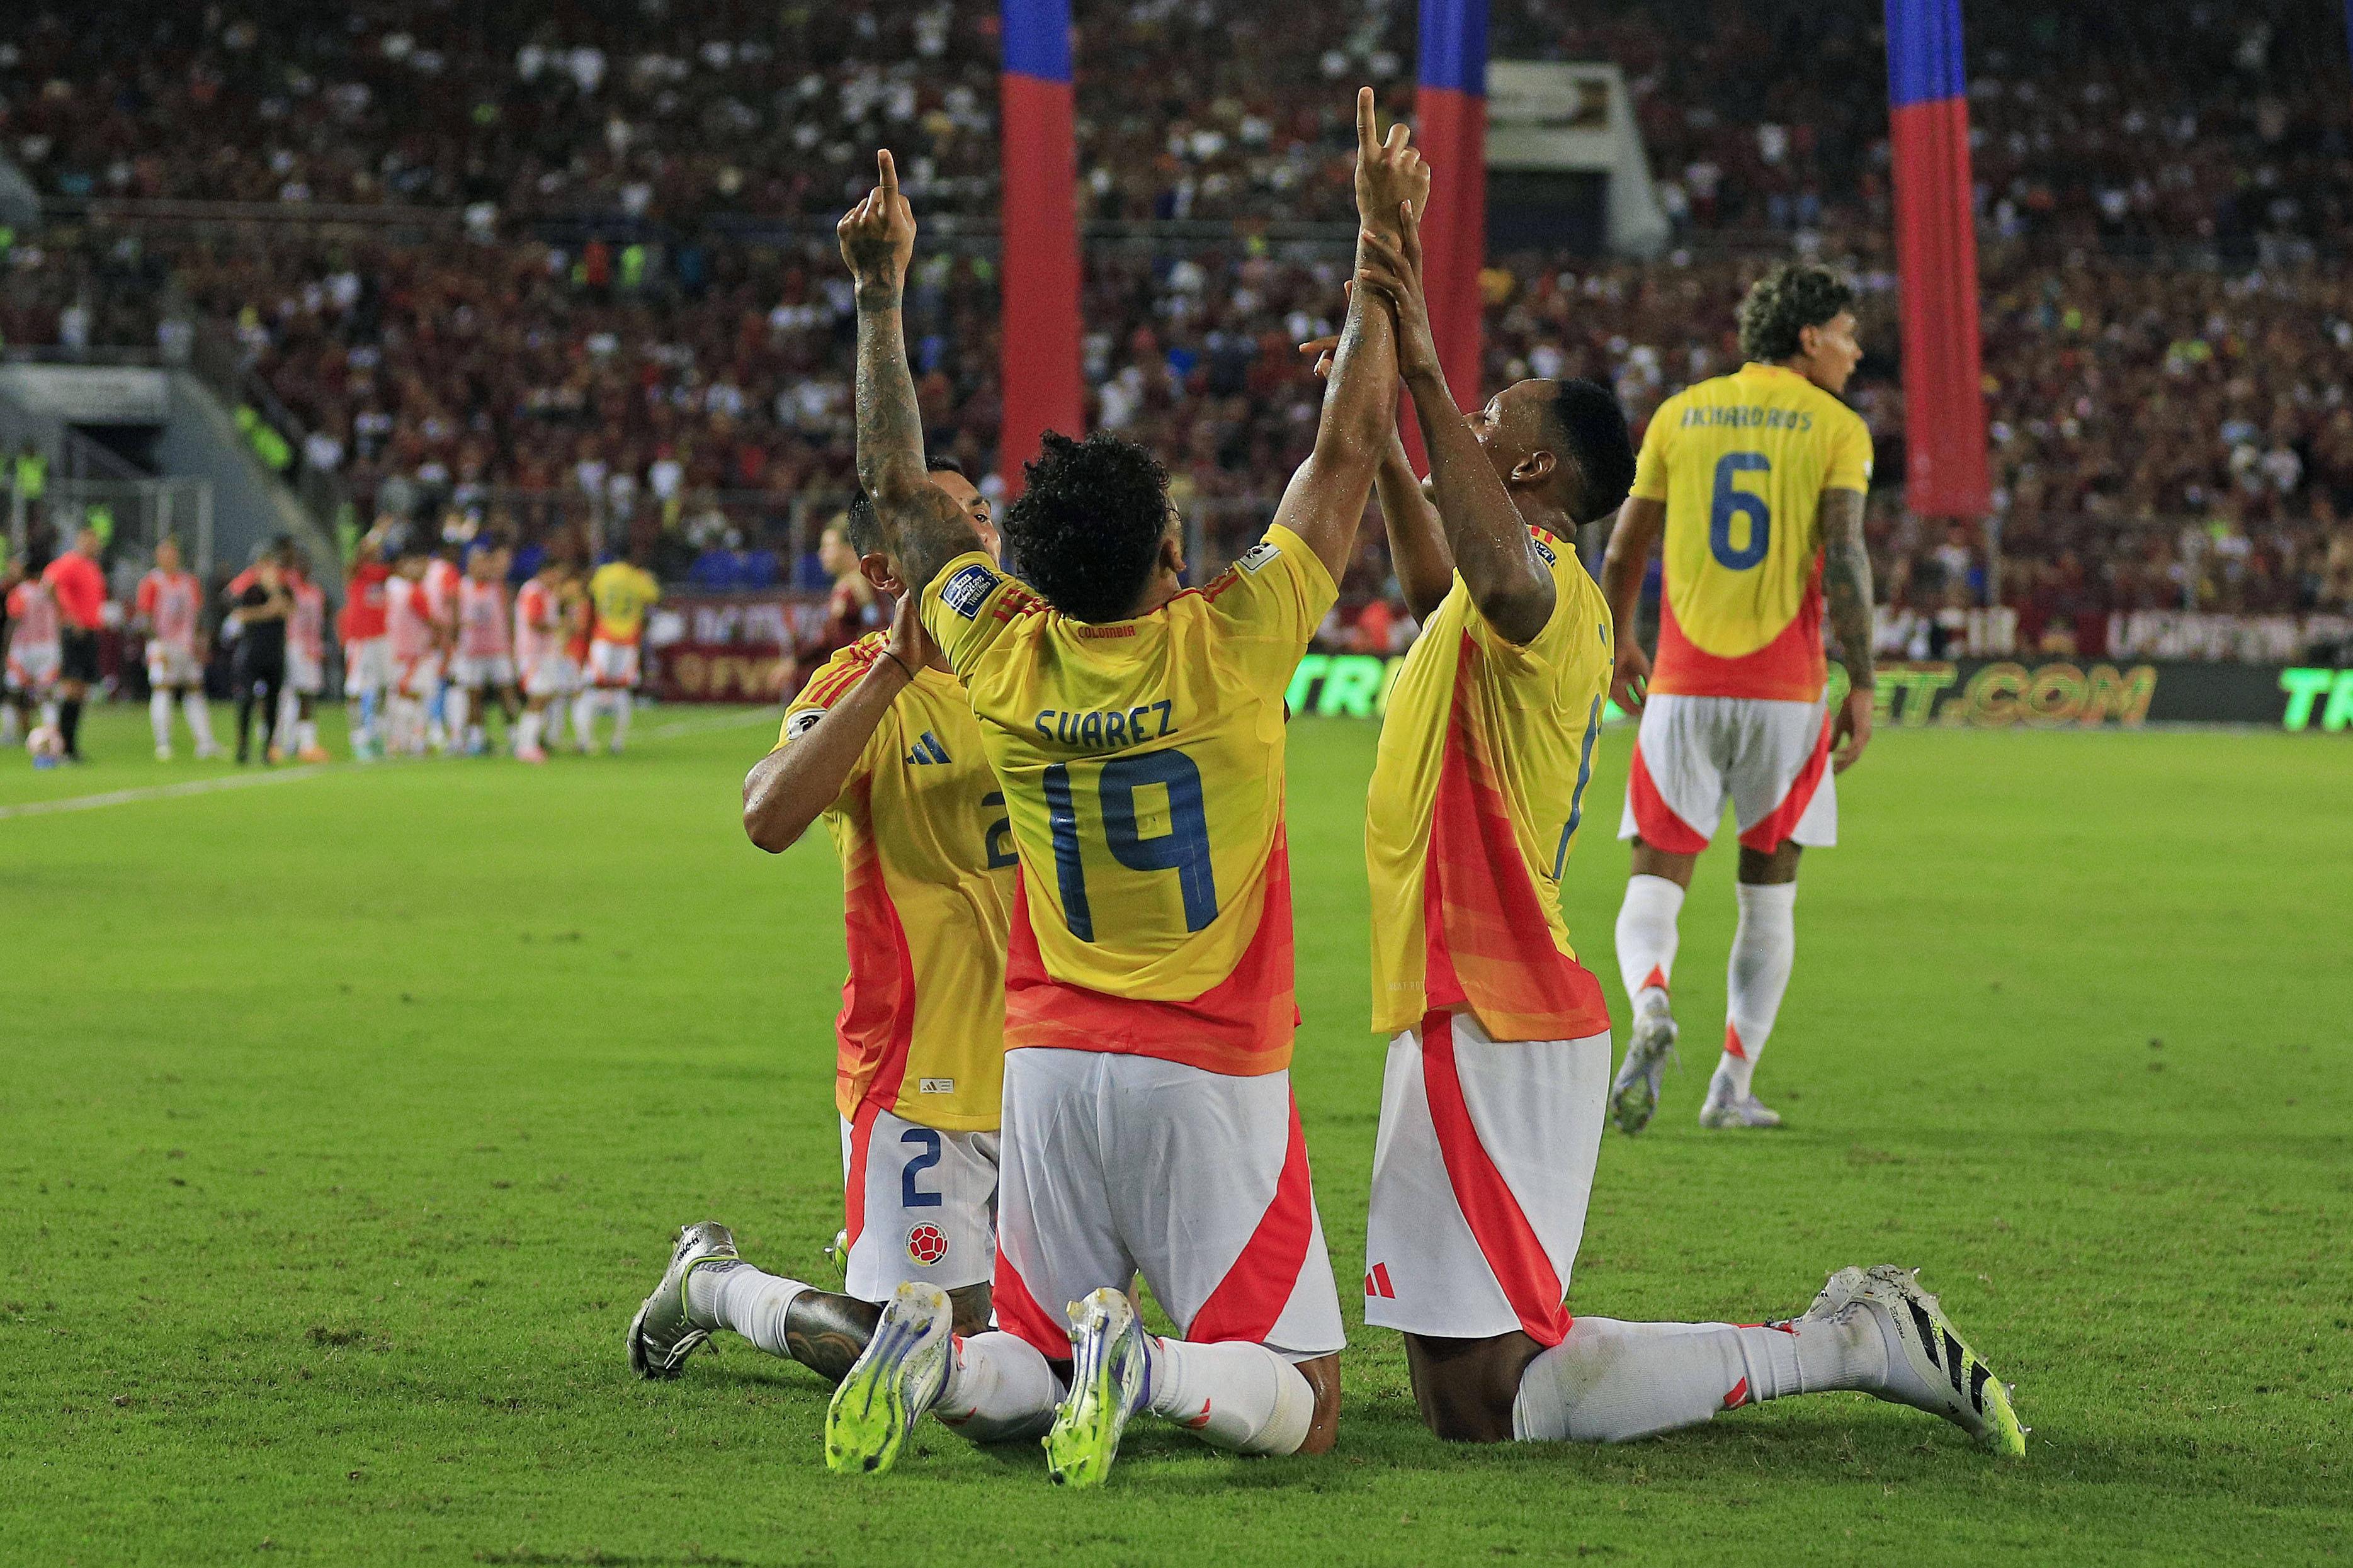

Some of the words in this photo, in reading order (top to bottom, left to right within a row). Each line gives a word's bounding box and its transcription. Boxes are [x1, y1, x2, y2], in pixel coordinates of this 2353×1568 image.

[1709, 451, 1771, 570] 6
[1078, 625, 1135, 638] COLOMBIA
[1035, 699, 1179, 749] SUAREZ
[1042, 748, 1218, 943] 19
[900, 1128, 942, 1207] 2
